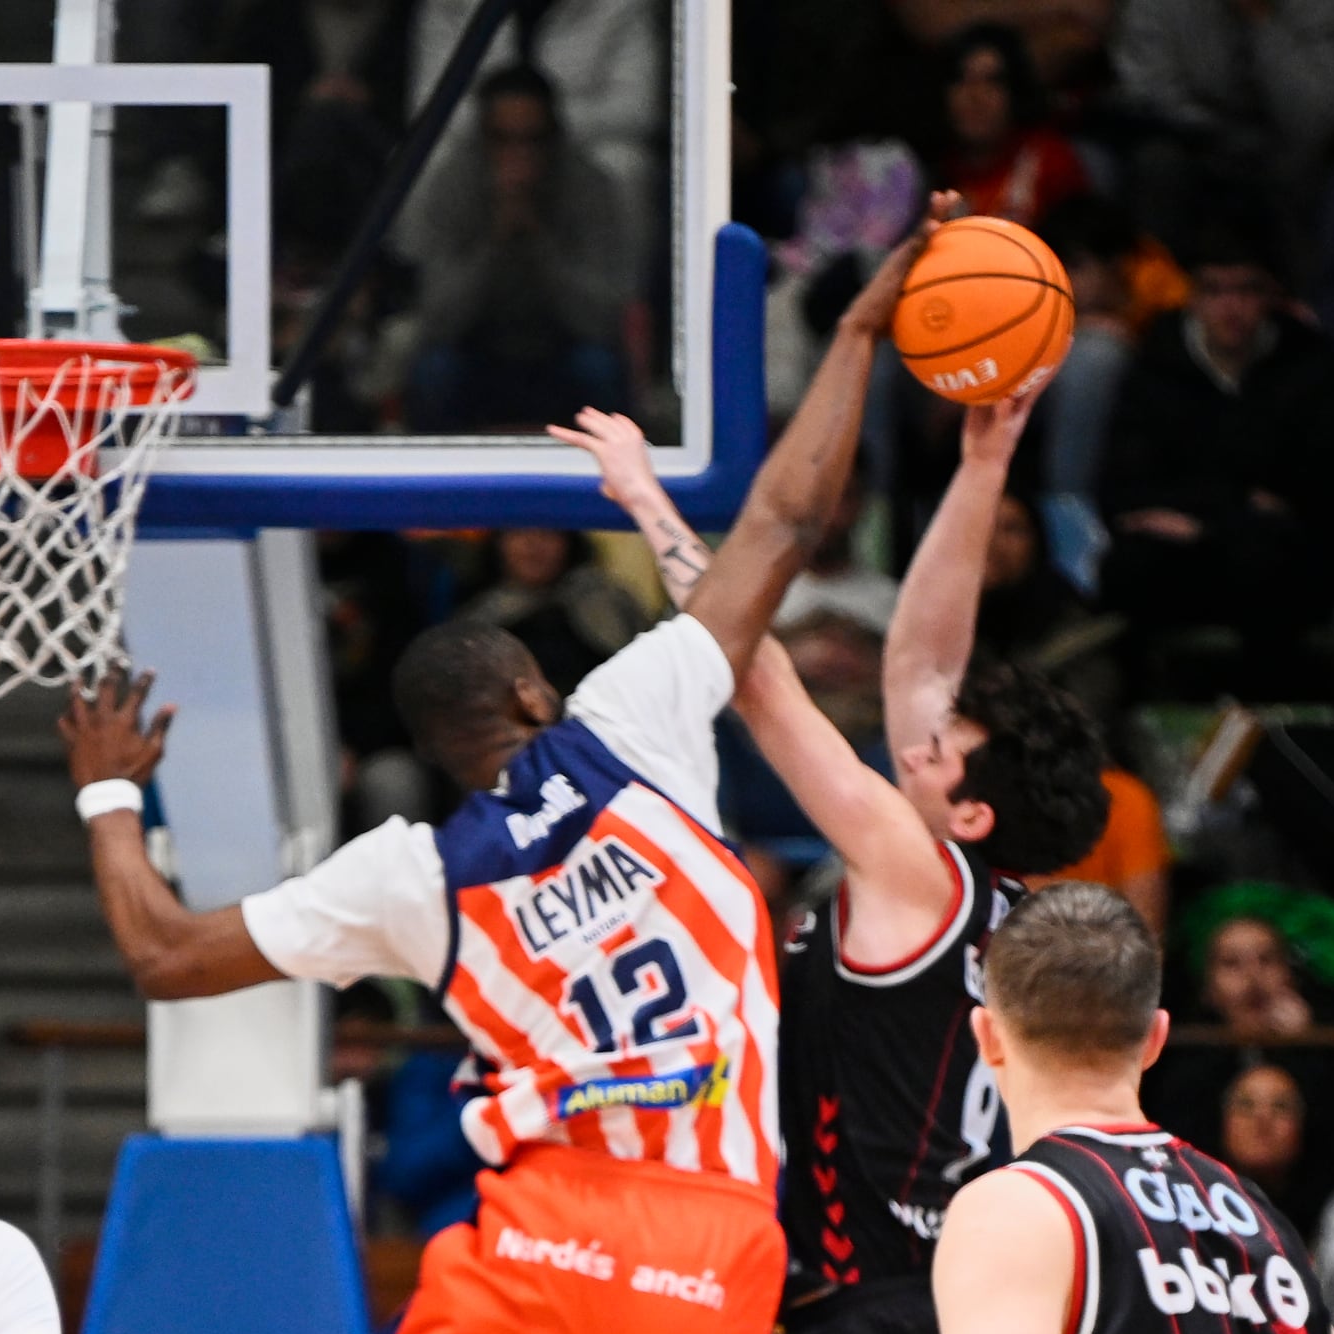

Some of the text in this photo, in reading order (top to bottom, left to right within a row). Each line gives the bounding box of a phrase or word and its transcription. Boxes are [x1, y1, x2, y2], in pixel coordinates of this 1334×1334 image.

[515, 842, 655, 953] LEYMA
[568, 938, 699, 1054] 12
[564, 1078, 688, 1114] Aluman
[495, 1226, 616, 1282] Nordés
